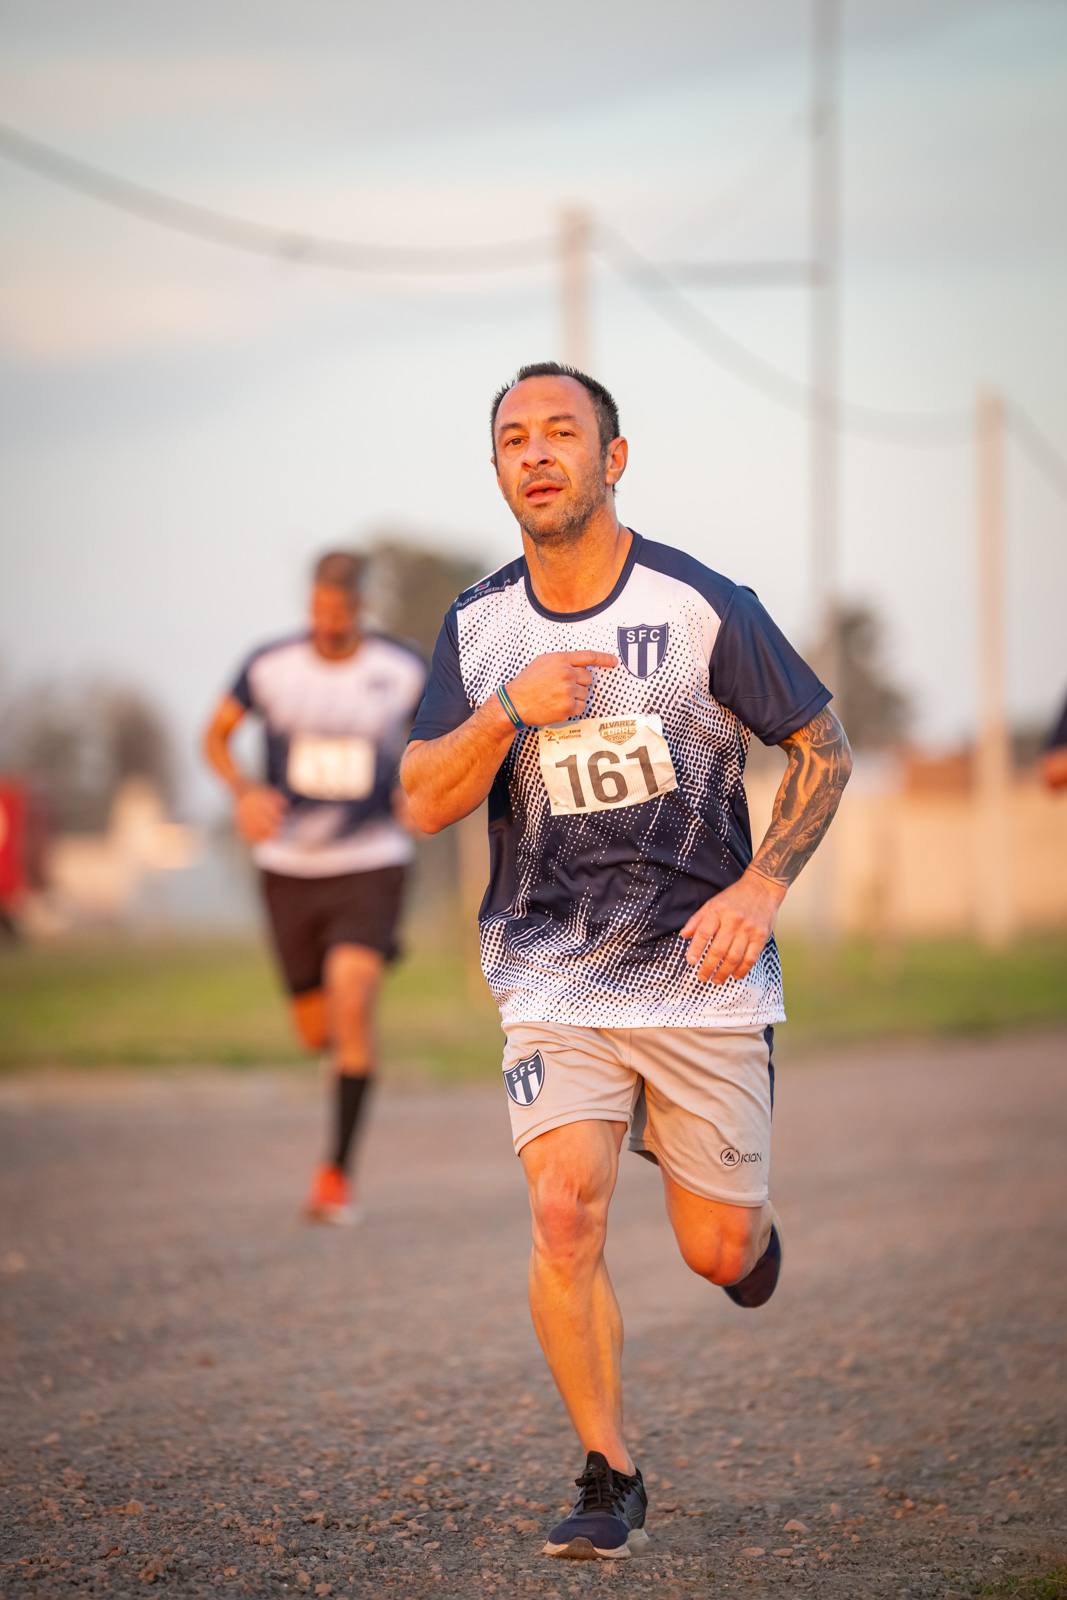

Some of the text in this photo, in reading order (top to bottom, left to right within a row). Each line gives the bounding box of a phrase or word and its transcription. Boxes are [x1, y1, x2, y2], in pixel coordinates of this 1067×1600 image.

[626, 629, 660, 643] SFC
[600, 719, 637, 730] ALVAREZ
[601, 726, 637, 737] CORRE
[555, 745, 659, 808] 161
[511, 1061, 536, 1082] SFC
